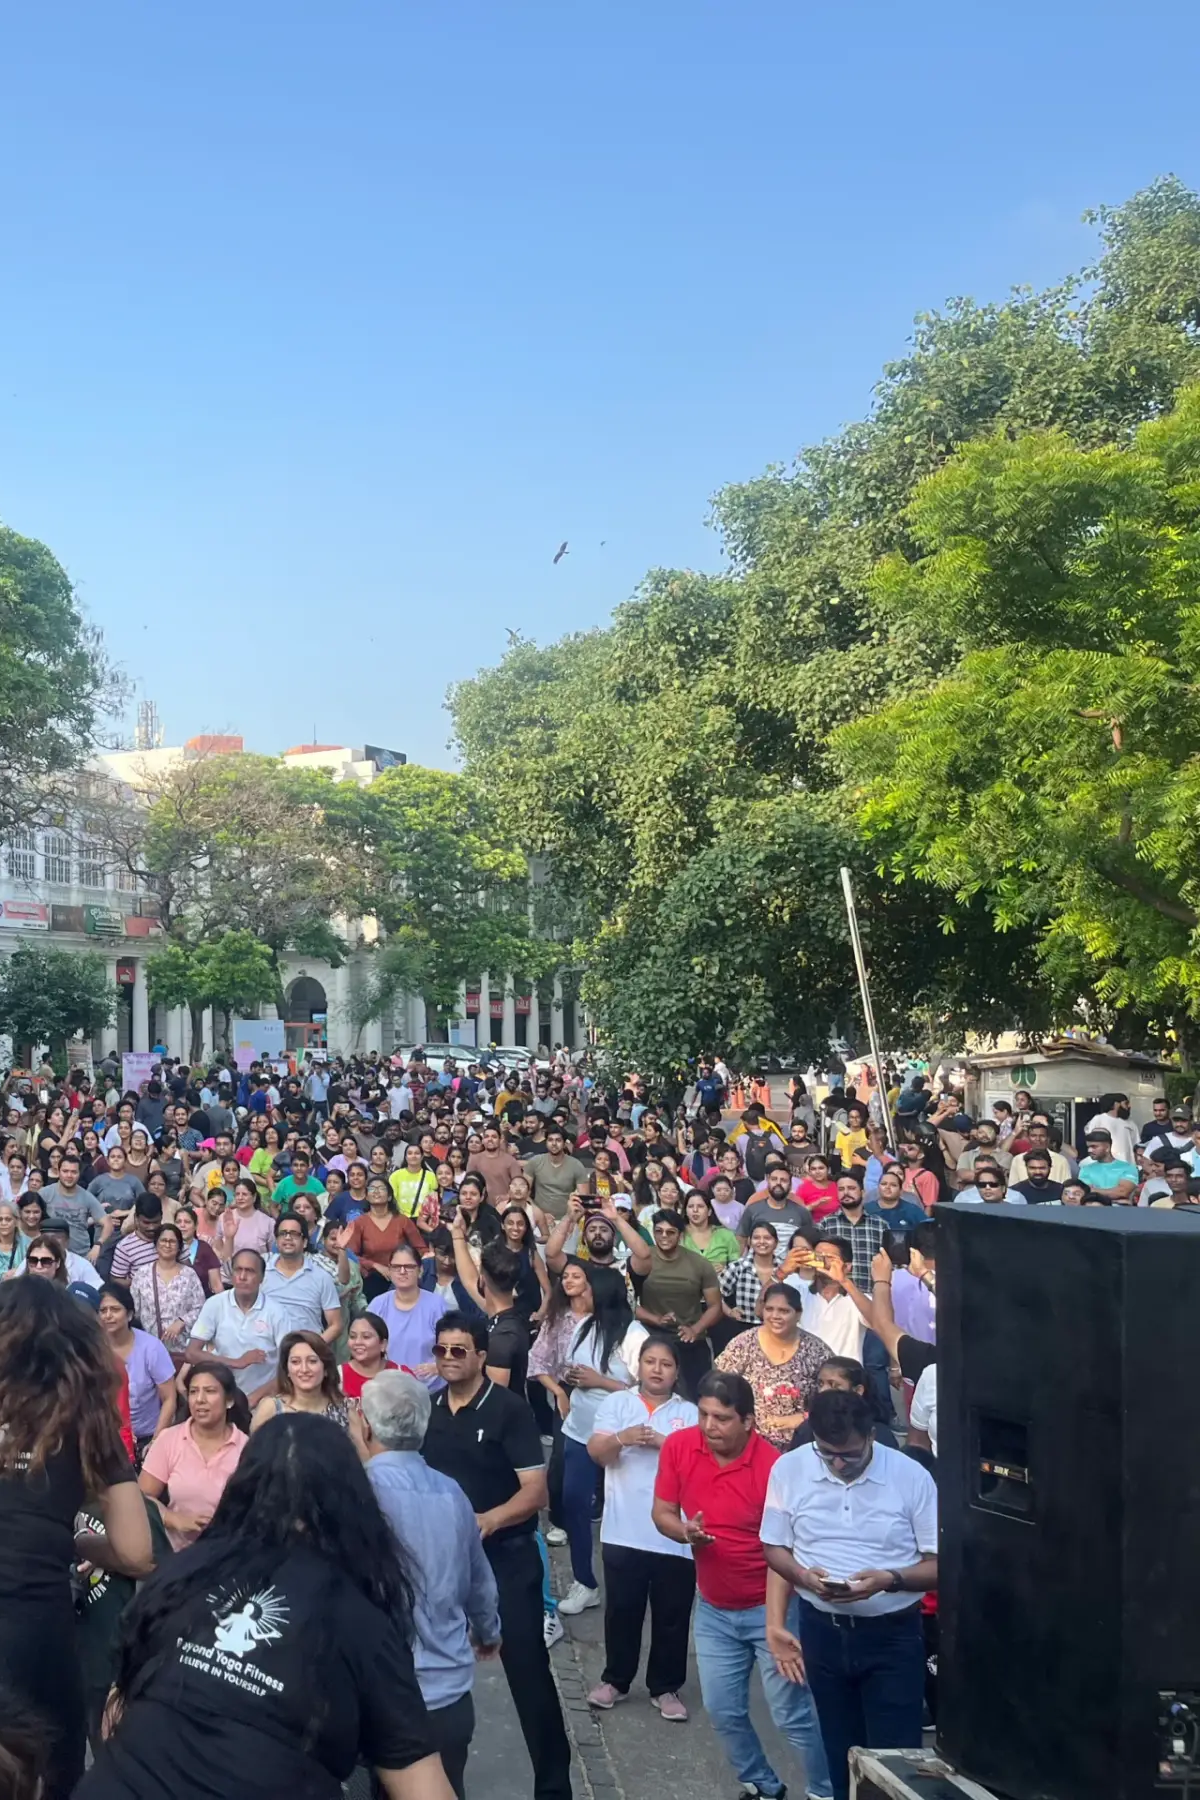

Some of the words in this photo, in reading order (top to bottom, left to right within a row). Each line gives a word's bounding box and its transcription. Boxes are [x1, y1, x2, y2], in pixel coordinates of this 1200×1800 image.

[210, 1665, 222, 1678] IN
[224, 1671, 267, 1697] YOURSELF
[216, 1651, 243, 1673] Yoga
[245, 1662, 285, 1692] Fitness
